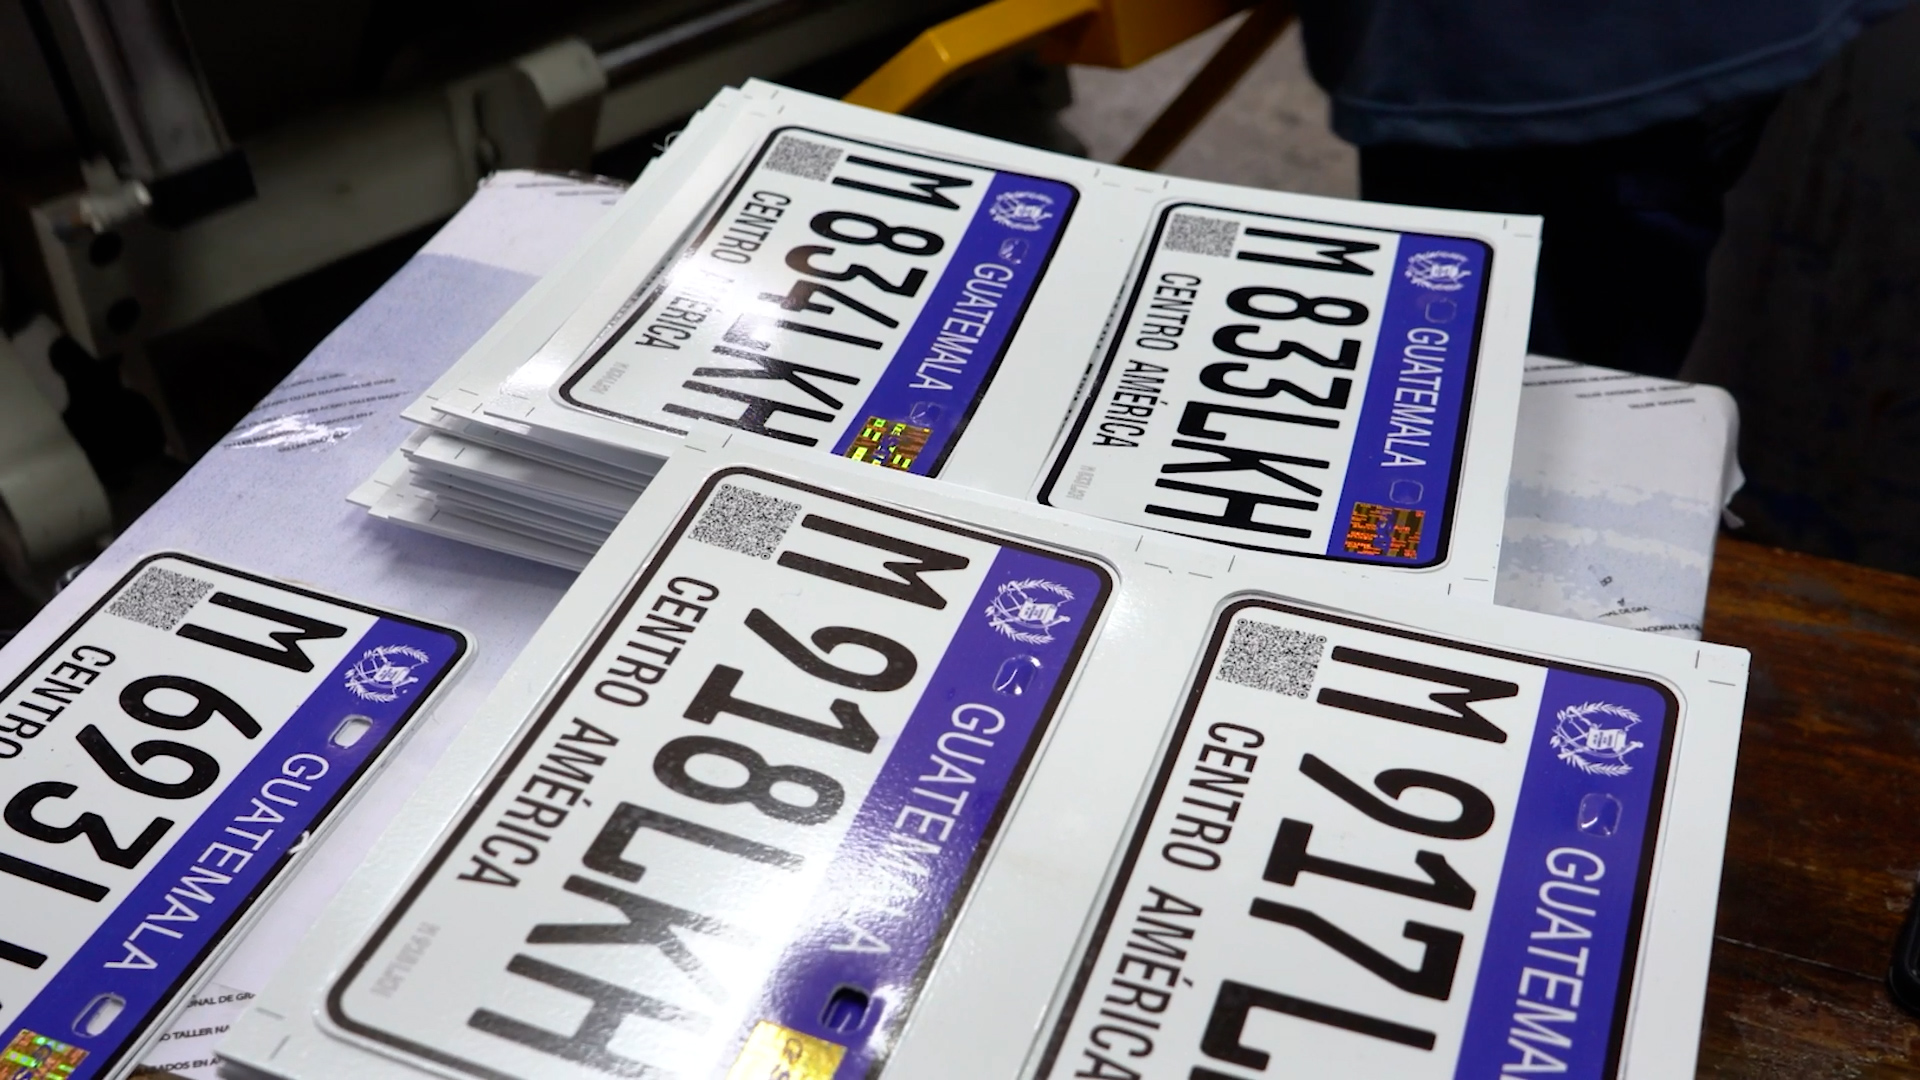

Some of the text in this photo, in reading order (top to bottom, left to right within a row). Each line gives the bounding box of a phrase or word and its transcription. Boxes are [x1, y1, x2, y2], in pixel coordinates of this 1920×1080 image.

[635, 190, 791, 352] CENTRO ÉRICA
[662, 155, 973, 447] M 834LKH
[909, 262, 1014, 392] GUATEMALA
[1092, 272, 1202, 448] CENTRO AMÉRICA
[1144, 227, 1380, 539] M 833LKH
[1381, 327, 1450, 468] GUATEMALA
[0, 645, 116, 759] CENTRO
[176, 591, 348, 673] M
[457, 576, 720, 889] CENTRO AMÉRICA
[466, 514, 970, 1080] M 918LKH
[103, 752, 330, 972] GUATEMALA
[1074, 721, 1265, 1080] CENTRO AMÉRICA
[1189, 645, 1520, 1080] M 917L
[173, 1027, 214, 1041] TALLER
[218, 994, 234, 1004] DE
[1500, 847, 1607, 1080] GUATEMA
